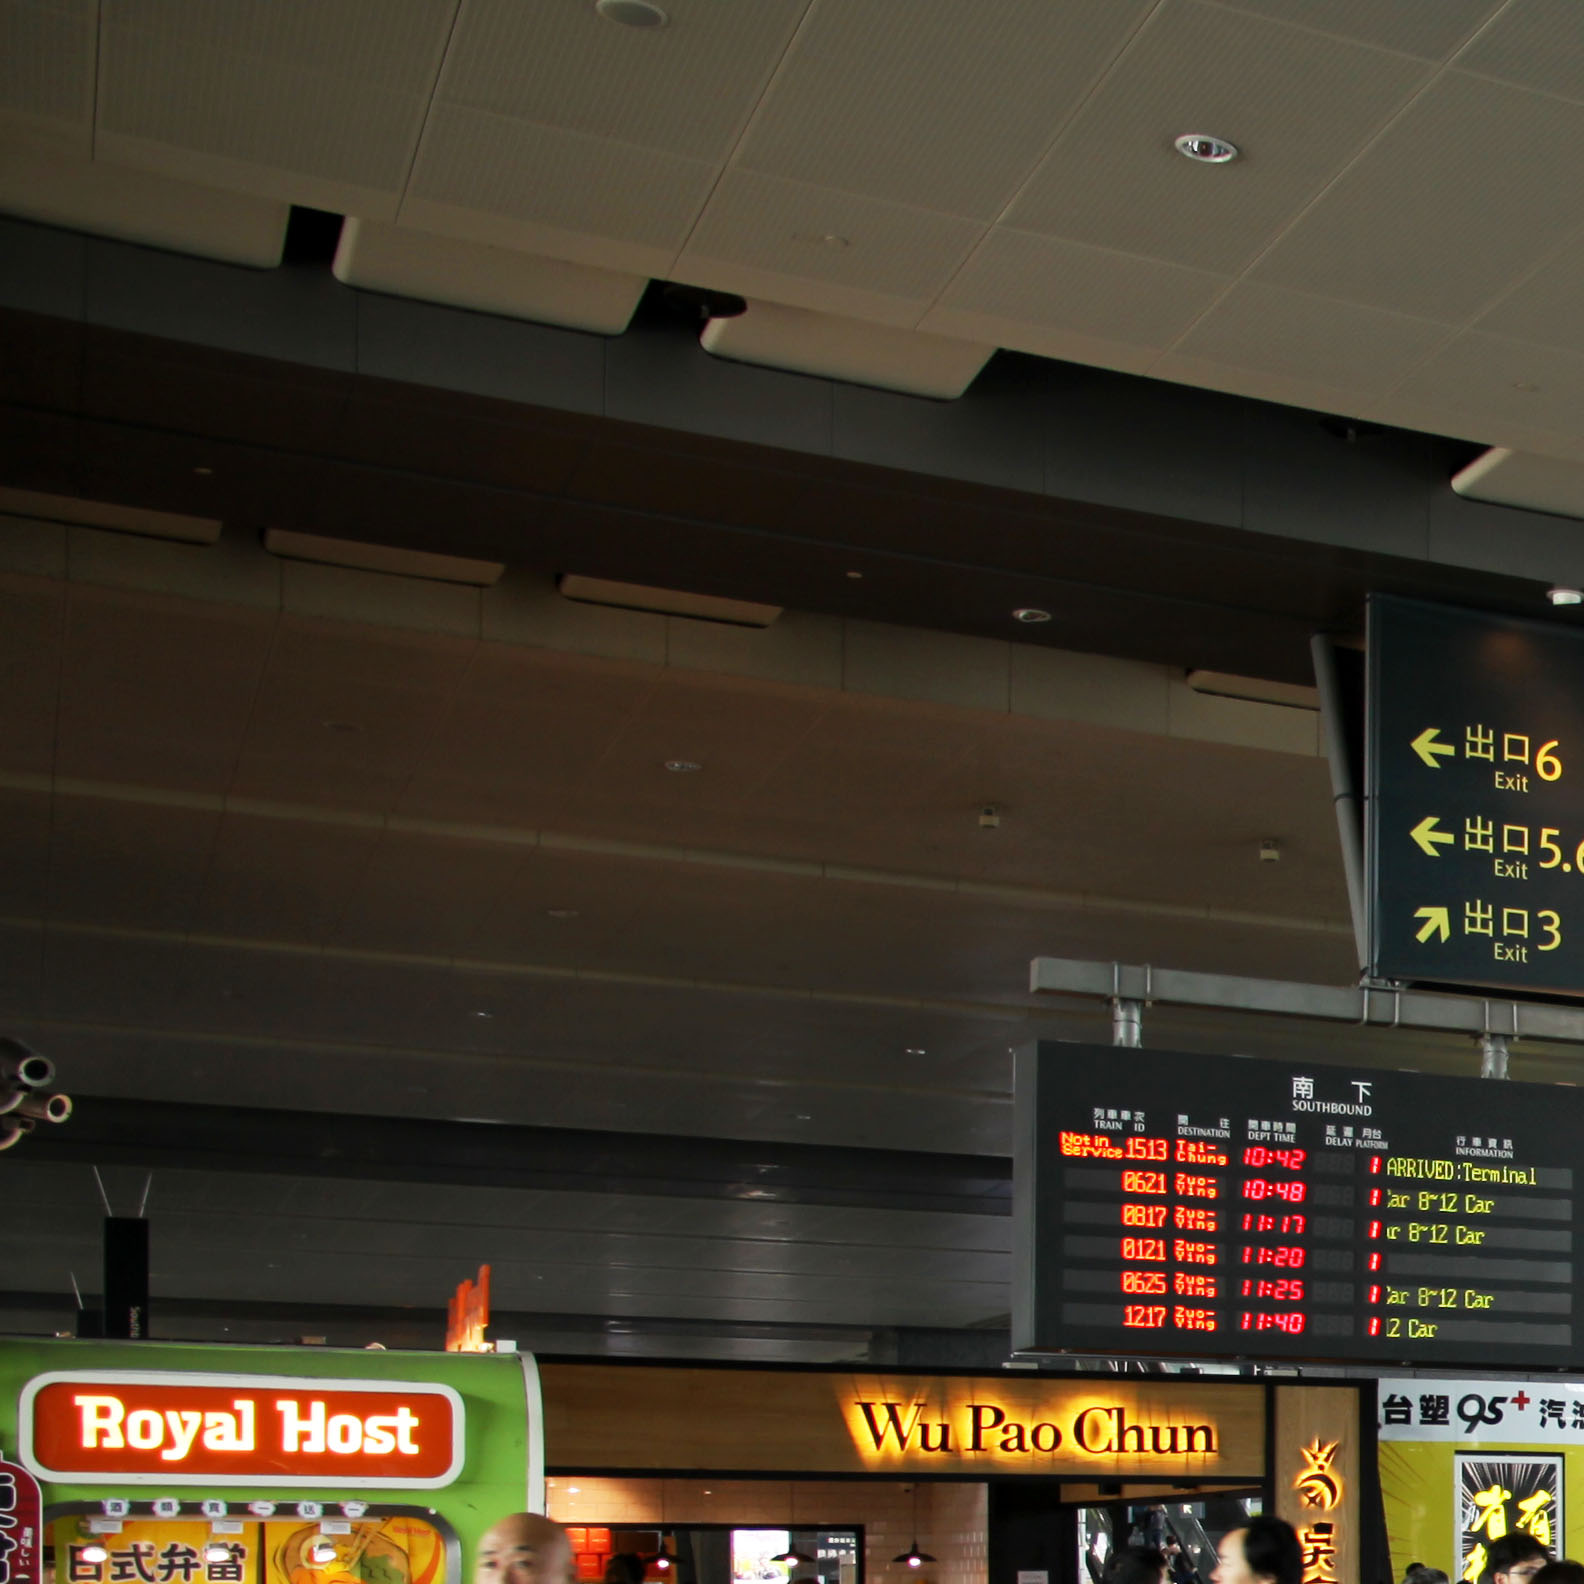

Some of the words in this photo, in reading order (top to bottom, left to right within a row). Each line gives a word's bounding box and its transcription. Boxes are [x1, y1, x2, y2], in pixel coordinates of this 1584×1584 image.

[1464, 724, 1529, 765] 出口
[1535, 740, 1562, 781] 6
[1495, 772, 1528, 793] Exit
[1464, 816, 1529, 856] 出口
[1494, 859, 1527, 880] Exit
[1464, 899, 1529, 938] 出口
[1537, 910, 1562, 951] 3
[1494, 943, 1528, 964] Exit
[1292, 1100, 1372, 1116] SOUTHBOUND
[1094, 1119, 1123, 1131] TRAIN
[1133, 1121, 1146, 1133] ID
[1177, 1126, 1231, 1140] DESTINATION
[1248, 1130, 1271, 1141] DEPT
[1274, 1132, 1296, 1143] TIME
[1060, 1132, 1091, 1146] Not
[1094, 1135, 1110, 1147] in
[1124, 1138, 1169, 1162] 1513
[1175, 1140, 1216, 1153] Tai-
[1325, 1136, 1353, 1147] DELAY
[1355, 1139, 1389, 1150] PLATFORM
[1061, 1142, 1124, 1160] Service
[1175, 1151, 1230, 1166] Chung
[1241, 1147, 1306, 1170] 10:42
[1455, 1147, 1514, 1159] INFORMATION
[1121, 1170, 1168, 1194] 0621
[1241, 1181, 1306, 1203] 10:48
[1465, 1194, 1494, 1213] Car
[1120, 1203, 1168, 1228] 0817
[1241, 1213, 1306, 1234] 11:17
[1456, 1225, 1485, 1245] Car
[1120, 1237, 1167, 1262] 0121
[1241, 1246, 1306, 1269] 11:20
[1120, 1271, 1168, 1295] 0625
[1240, 1279, 1304, 1301] 11:25
[1464, 1289, 1494, 1309] Car
[1122, 1305, 1168, 1329] 1217
[1240, 1312, 1306, 1335] 11:40
[1408, 1319, 1438, 1339] Car
[1382, 1394, 1450, 1427] 台塑
[74, 1395, 257, 1461] Royal
[277, 1401, 420, 1456] Host
[855, 1401, 952, 1454] Wu
[966, 1403, 1062, 1454] Pao
[1073, 1406, 1217, 1454] Chun
